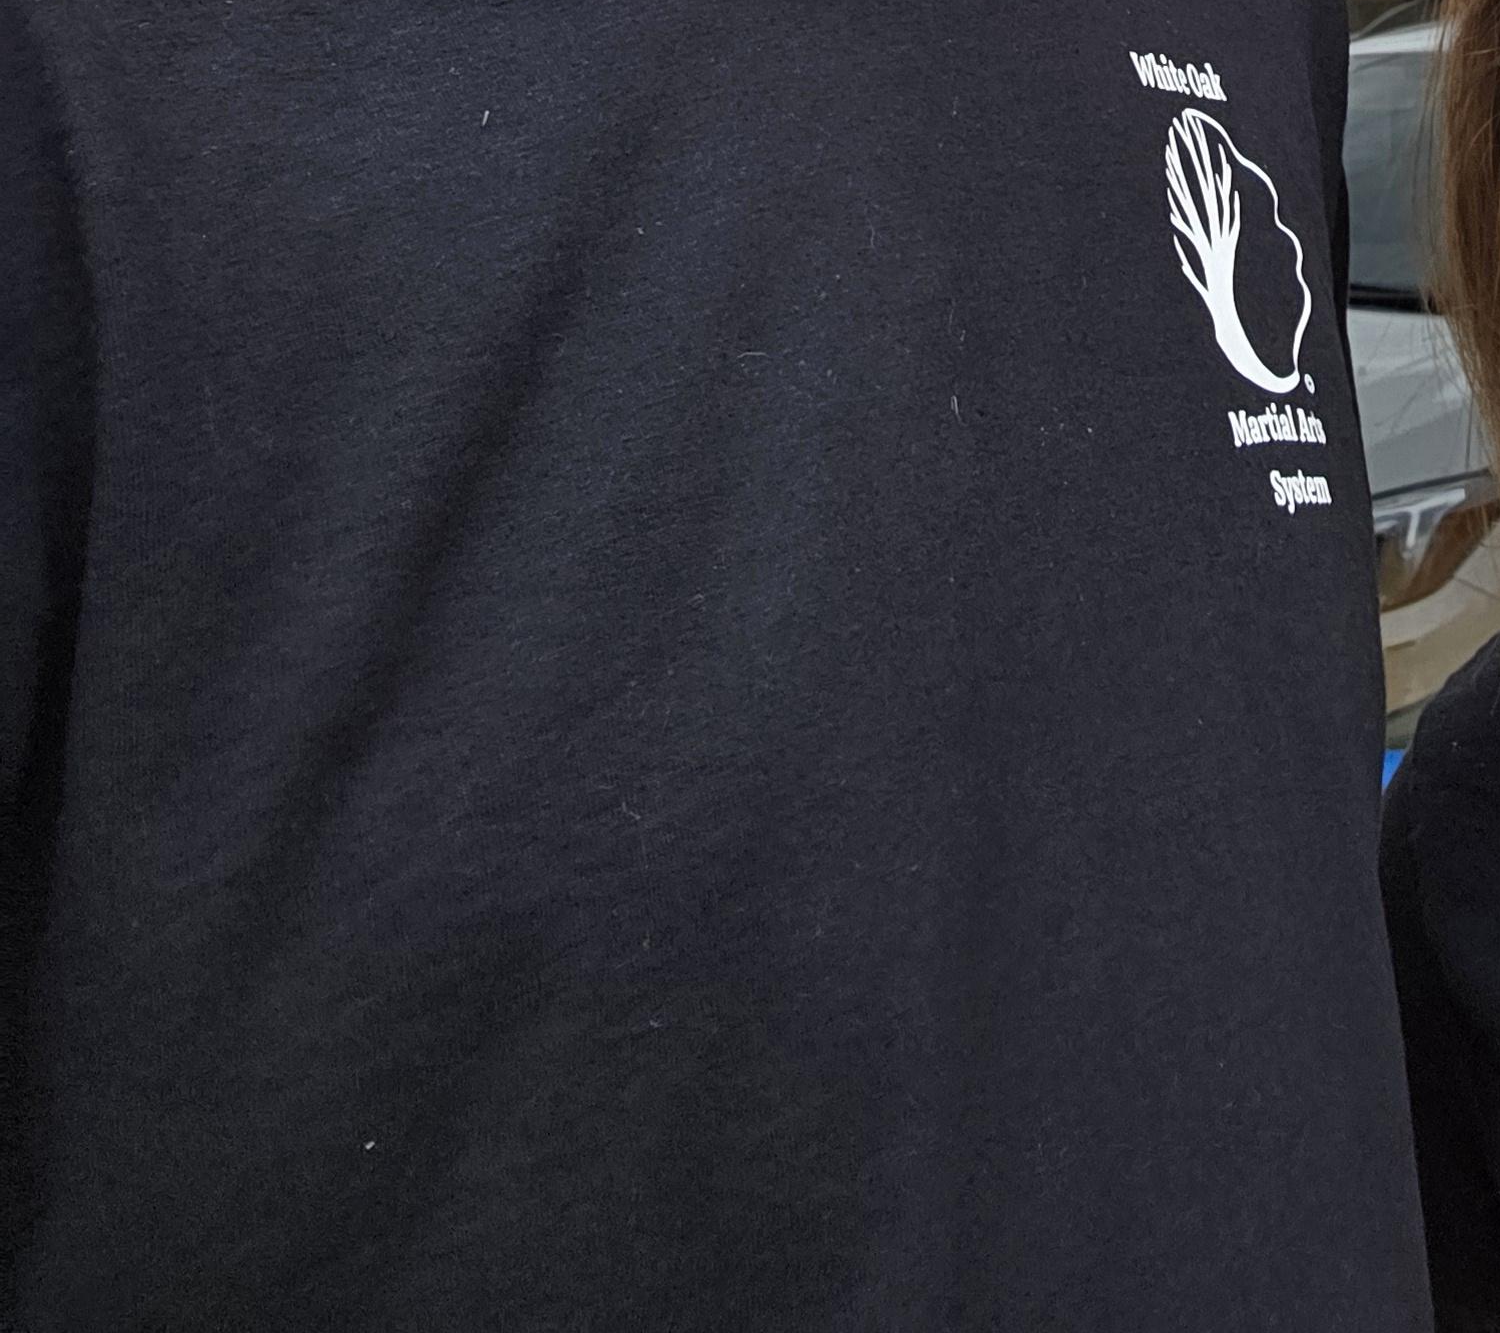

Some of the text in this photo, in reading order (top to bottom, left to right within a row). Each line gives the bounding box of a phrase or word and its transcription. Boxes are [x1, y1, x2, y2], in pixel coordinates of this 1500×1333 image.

[1129, 51, 1228, 102] White Oak
[1227, 402, 1327, 448] Martial Arts
[1269, 469, 1333, 515] System
